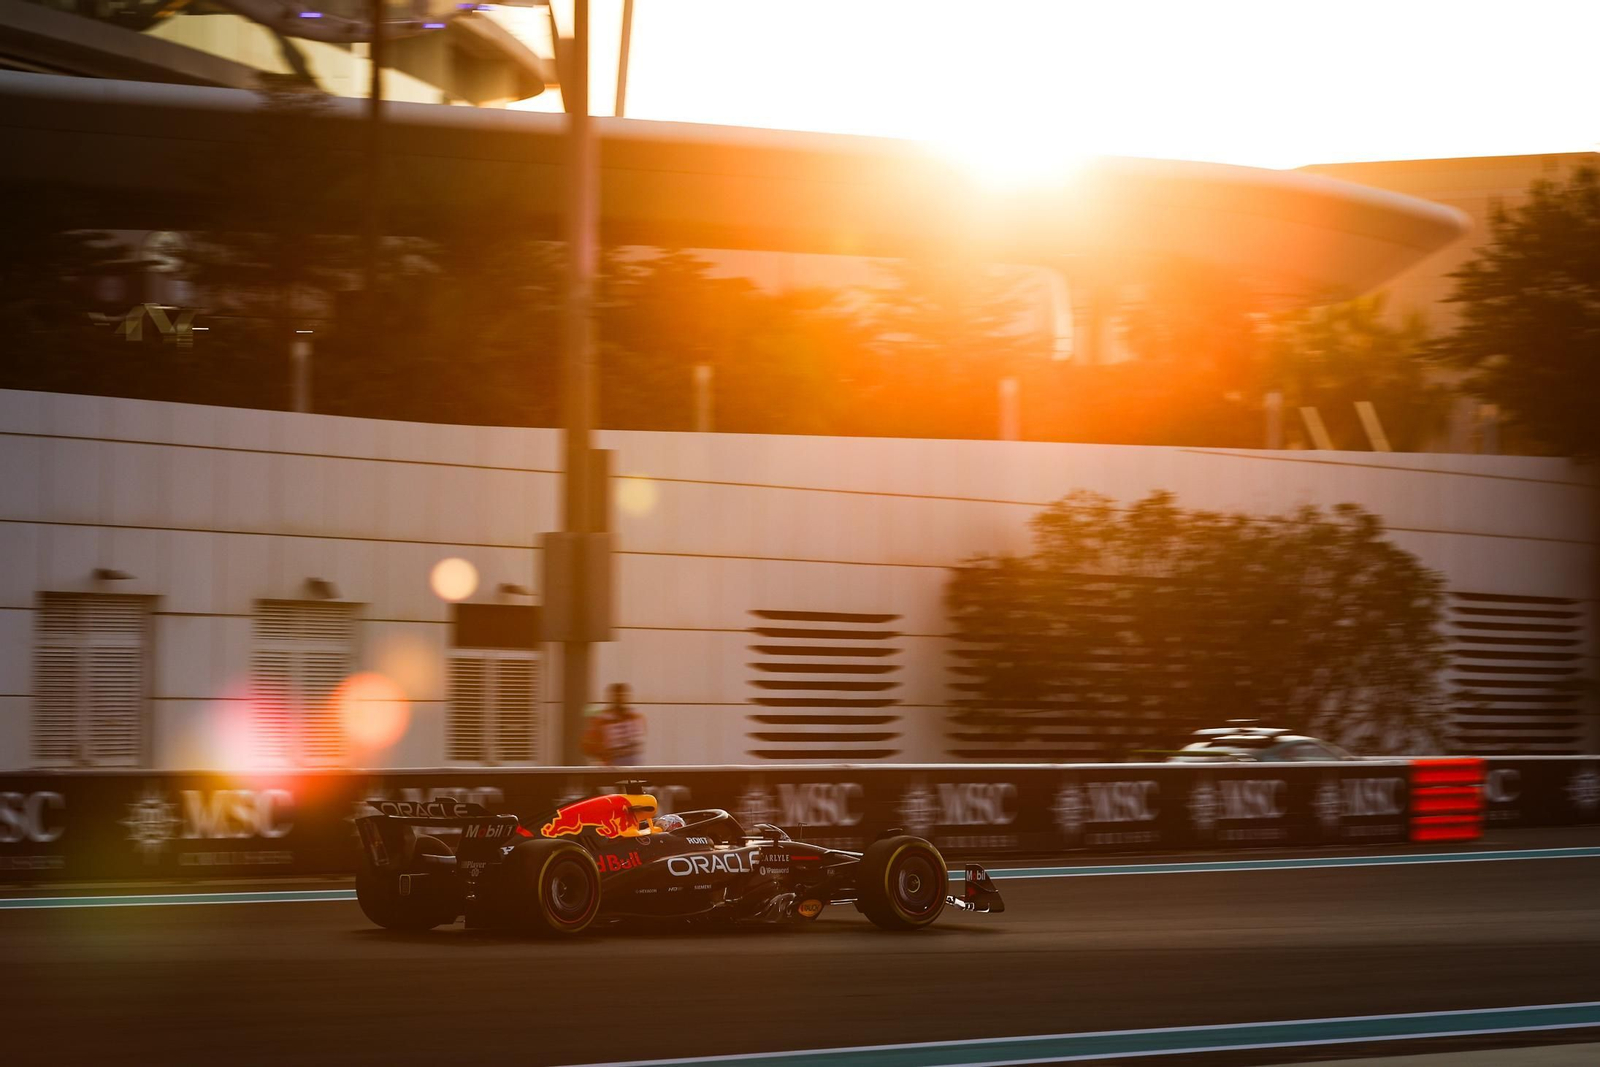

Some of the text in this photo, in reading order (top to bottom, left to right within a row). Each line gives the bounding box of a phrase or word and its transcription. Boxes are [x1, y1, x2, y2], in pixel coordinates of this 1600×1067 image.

[0, 791, 66, 842] SC
[181, 789, 294, 839] MSC
[381, 802, 468, 818] ORACLE
[776, 784, 865, 827] MSC
[937, 783, 1018, 825] MSC
[465, 824, 503, 838] Mobil
[606, 852, 643, 872] Bull
[966, 870, 986, 882] Mobil
